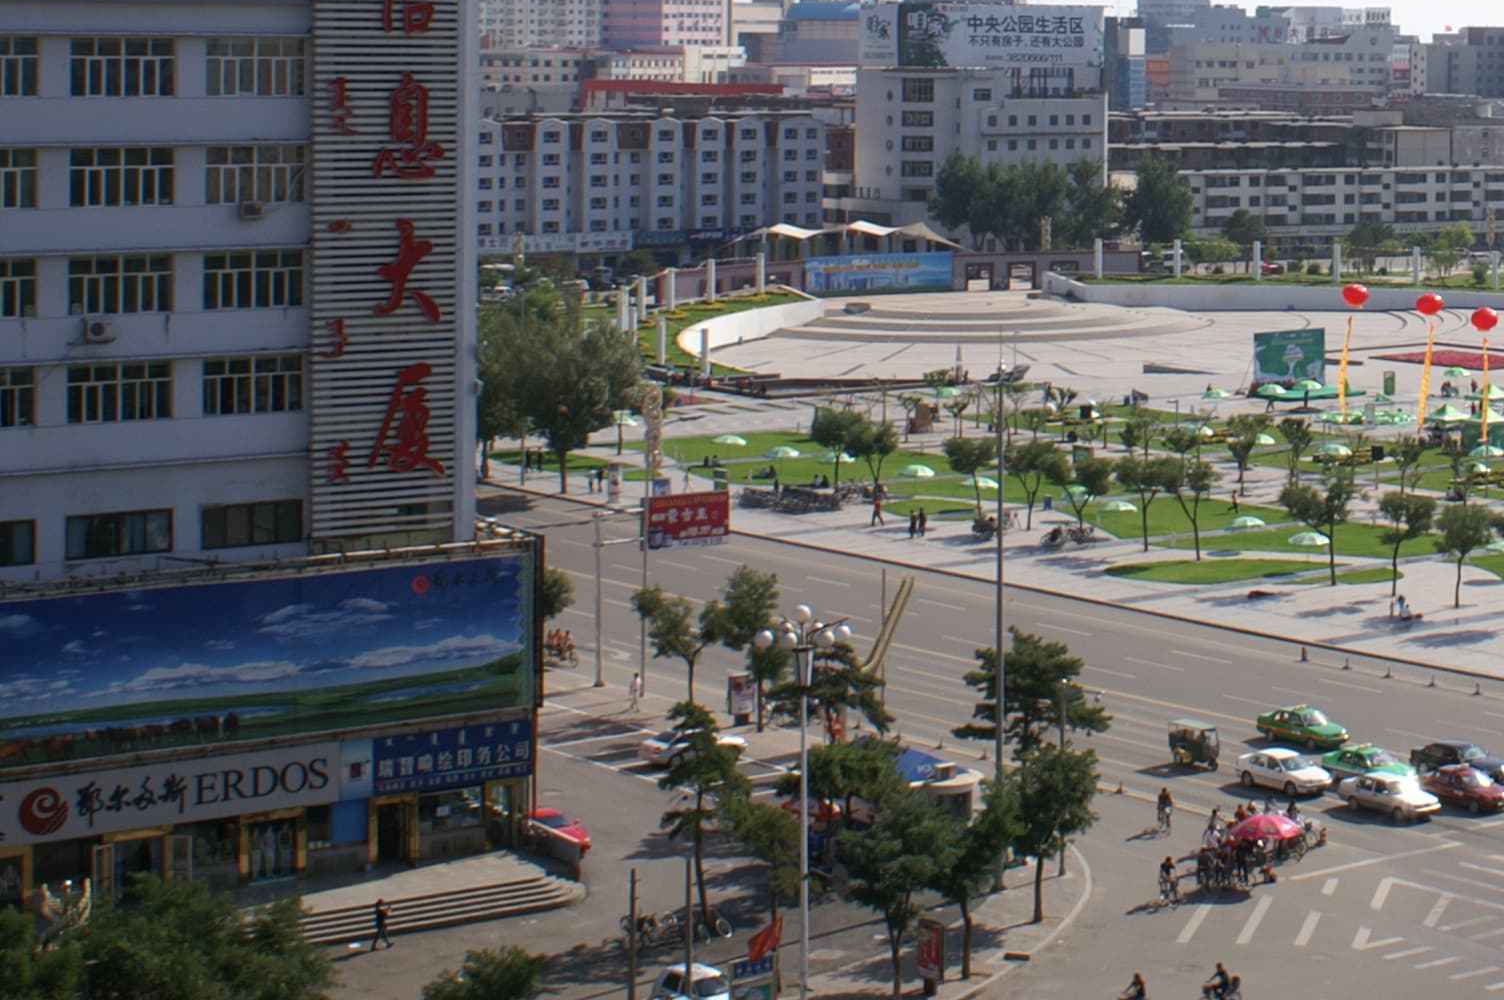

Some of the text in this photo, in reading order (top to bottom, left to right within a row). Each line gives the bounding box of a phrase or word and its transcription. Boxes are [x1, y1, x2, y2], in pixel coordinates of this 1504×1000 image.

[967, 14, 1085, 34] 中央公园生活区
[194, 757, 329, 806] ERDOS
